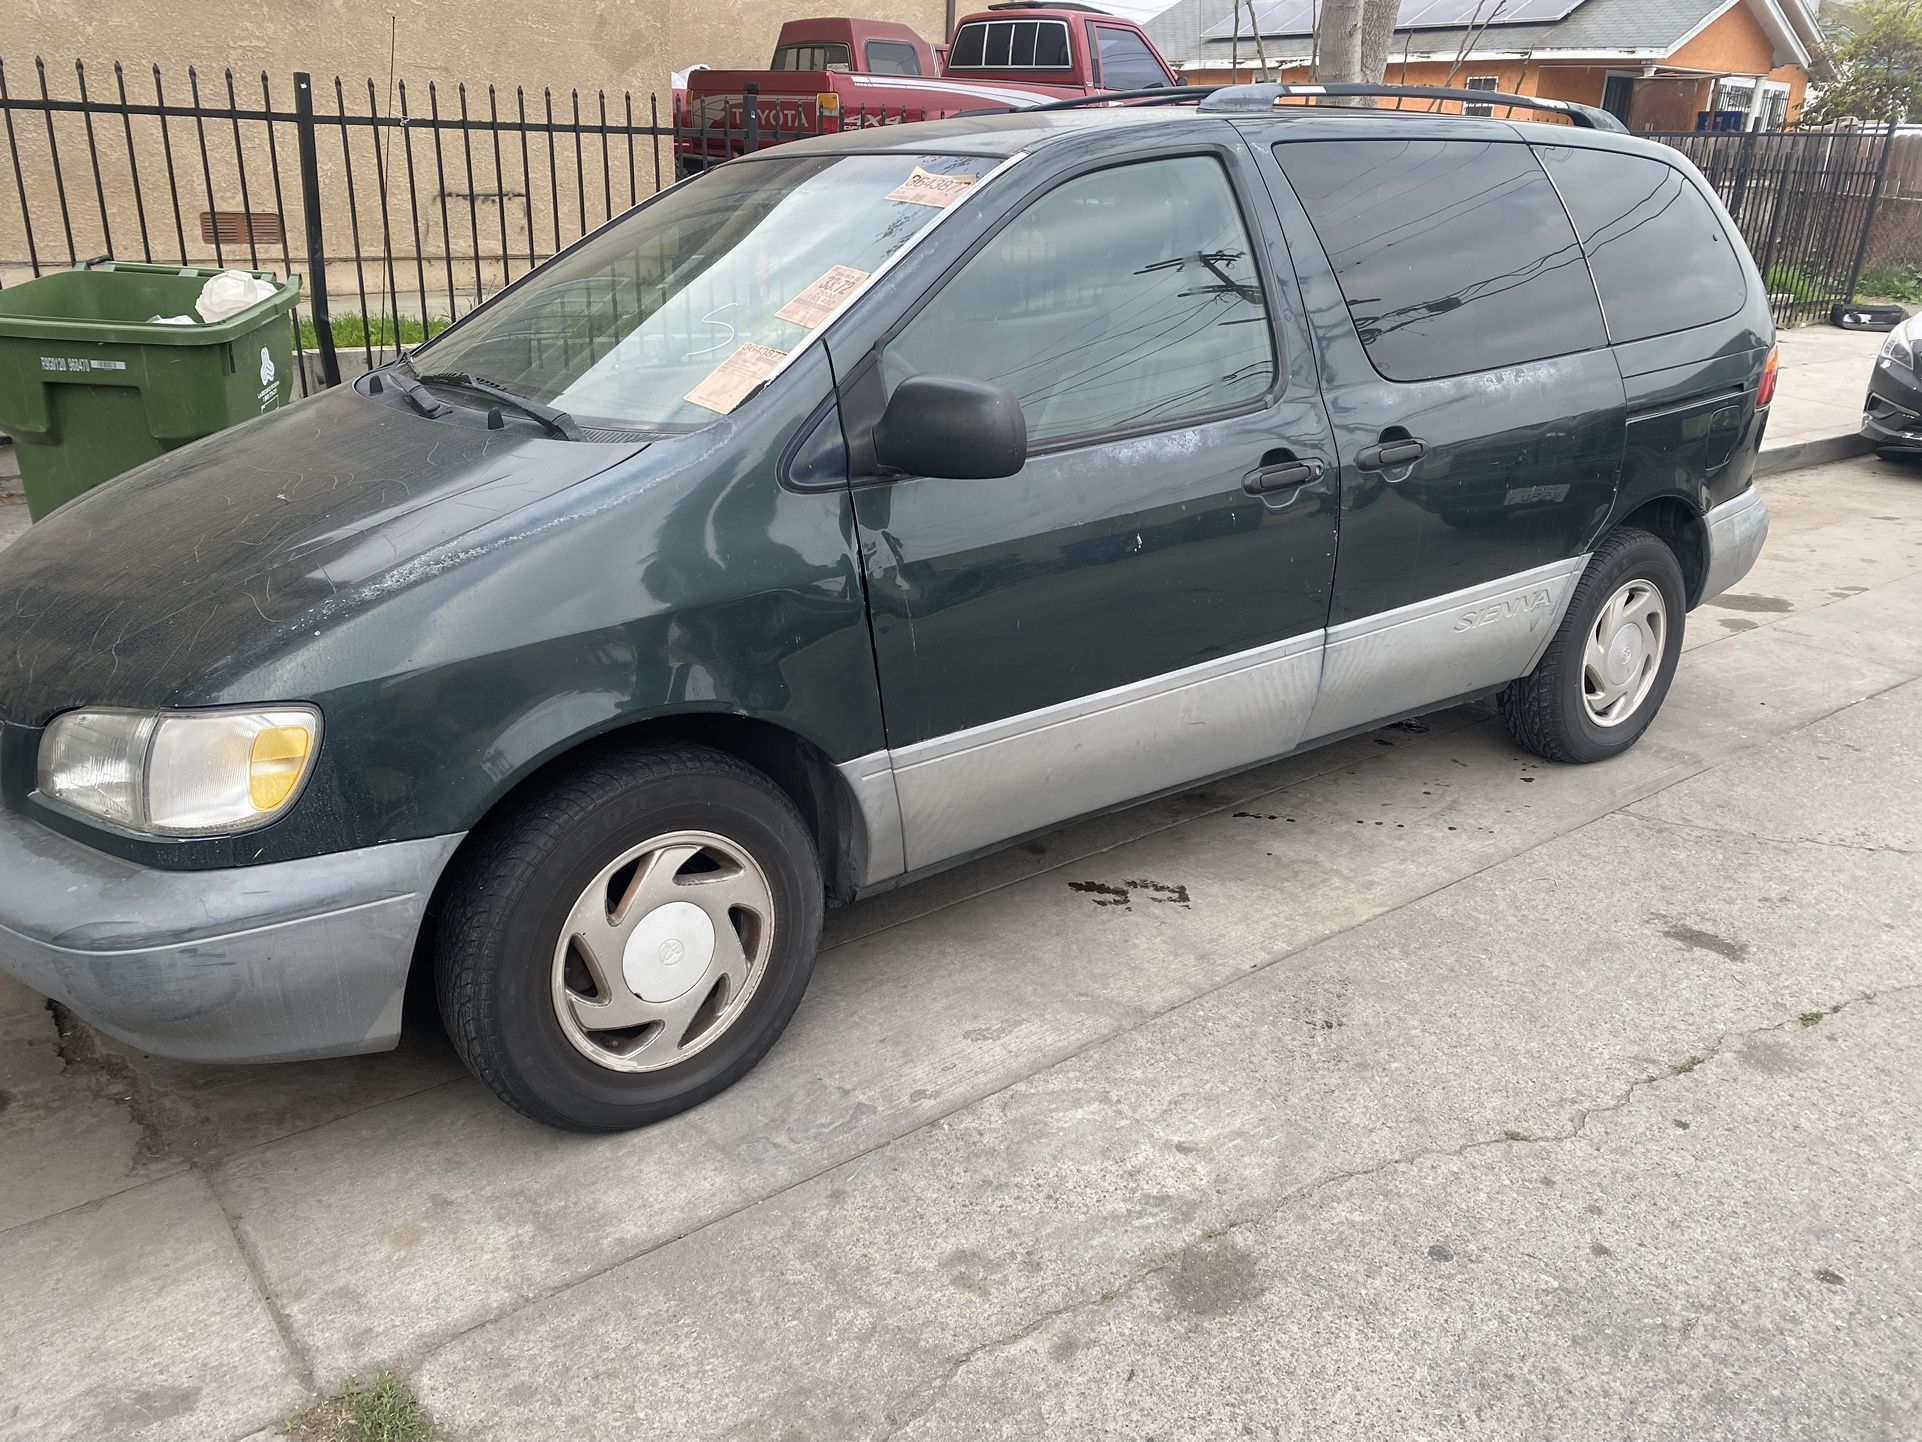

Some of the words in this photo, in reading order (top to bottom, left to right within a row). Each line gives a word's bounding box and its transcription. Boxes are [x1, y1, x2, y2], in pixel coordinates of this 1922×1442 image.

[732, 108, 809, 128] TYOTA
[904, 174, 972, 194] 3643877
[1453, 588, 1551, 634] SIENNA
